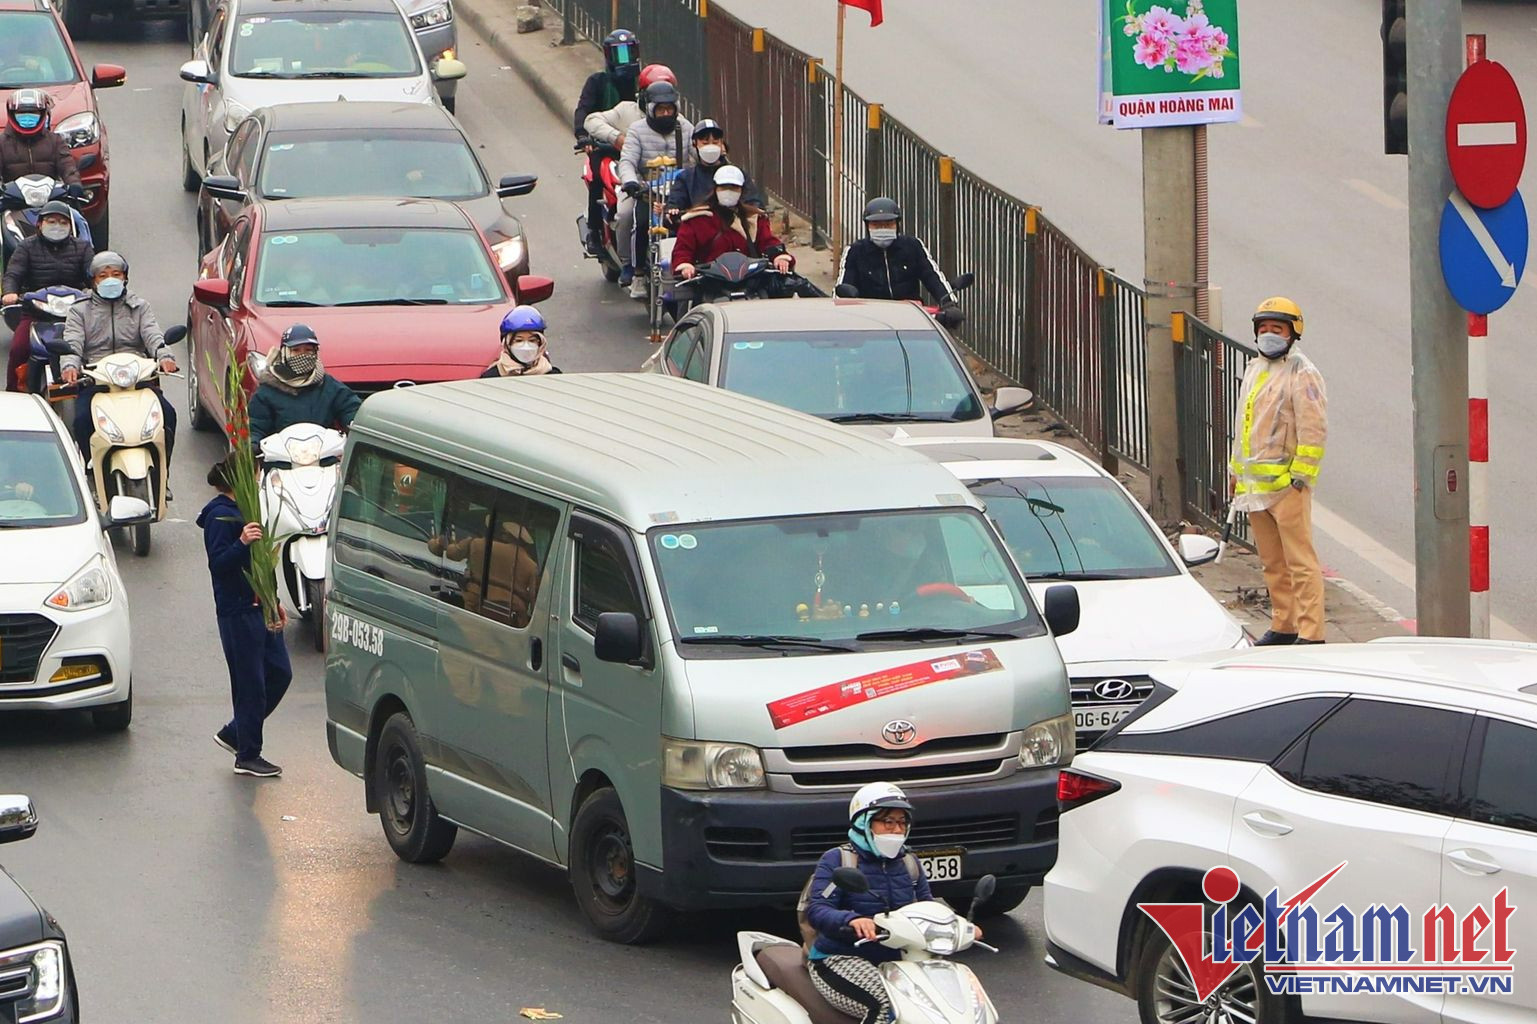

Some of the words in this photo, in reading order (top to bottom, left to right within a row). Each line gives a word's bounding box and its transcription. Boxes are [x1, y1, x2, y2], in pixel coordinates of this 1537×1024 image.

[1119, 99, 1155, 117] QUẬN
[1160, 97, 1204, 114] HOÀNG
[1208, 97, 1234, 111] MAI
[332, 612, 384, 657] 29B-053.58
[923, 858, 958, 880] 3.58
